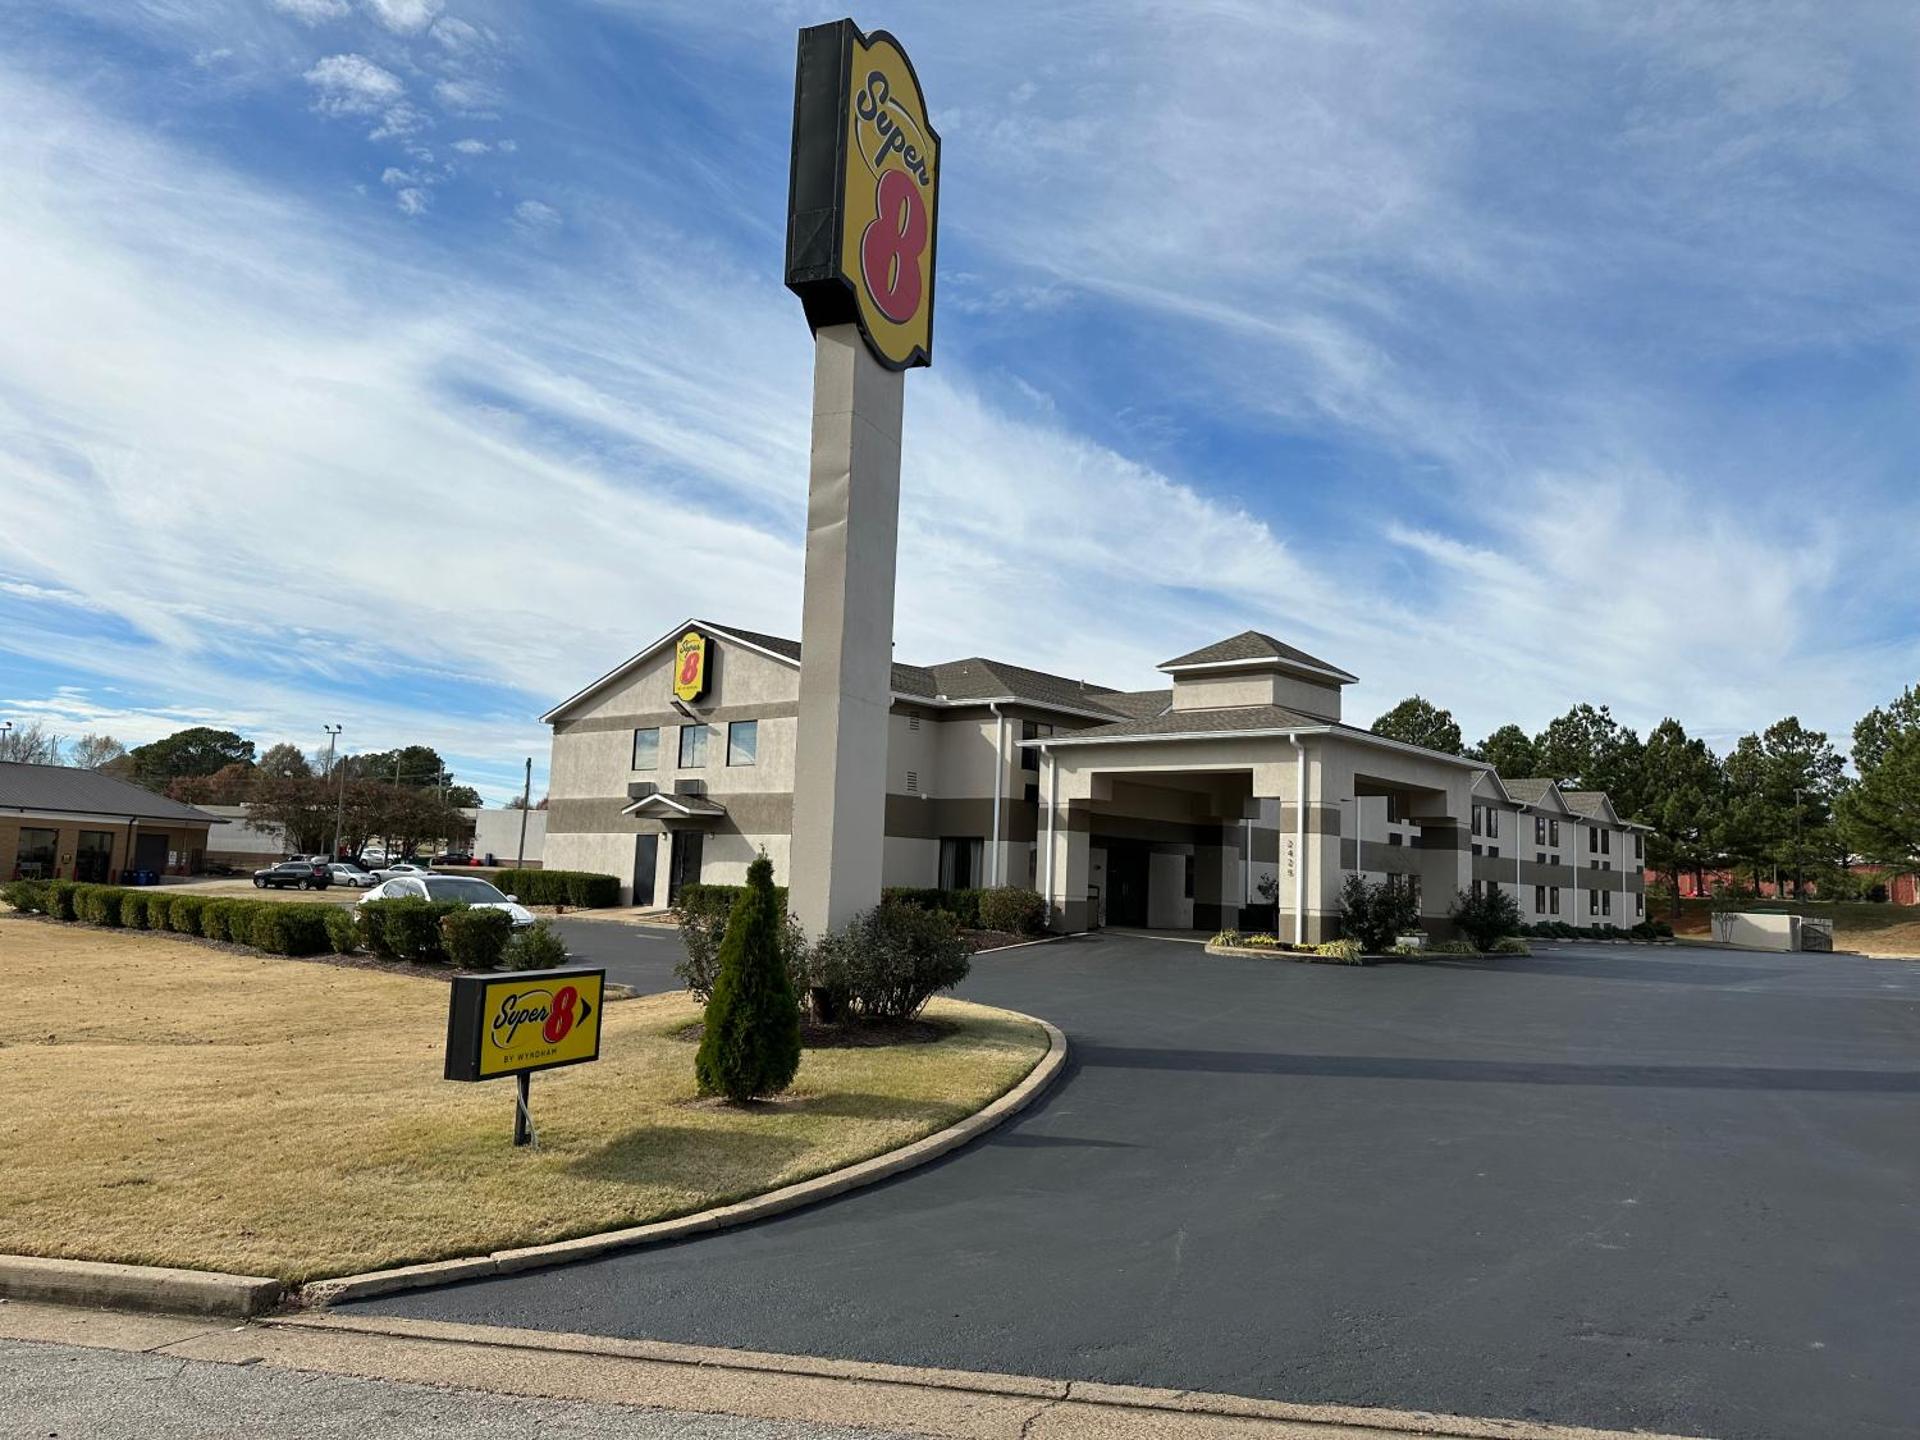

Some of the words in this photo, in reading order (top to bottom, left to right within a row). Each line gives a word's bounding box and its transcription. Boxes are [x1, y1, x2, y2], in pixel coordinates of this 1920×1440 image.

[856, 71, 929, 186] Super
[862, 168, 928, 325] 8
[680, 639, 701, 658] Super
[680, 650, 700, 685] 8
[493, 994, 550, 1044] Super
[543, 986, 579, 1044] 8
[503, 1055, 514, 1063] BY
[518, 1048, 557, 1061] WYNDHAM
